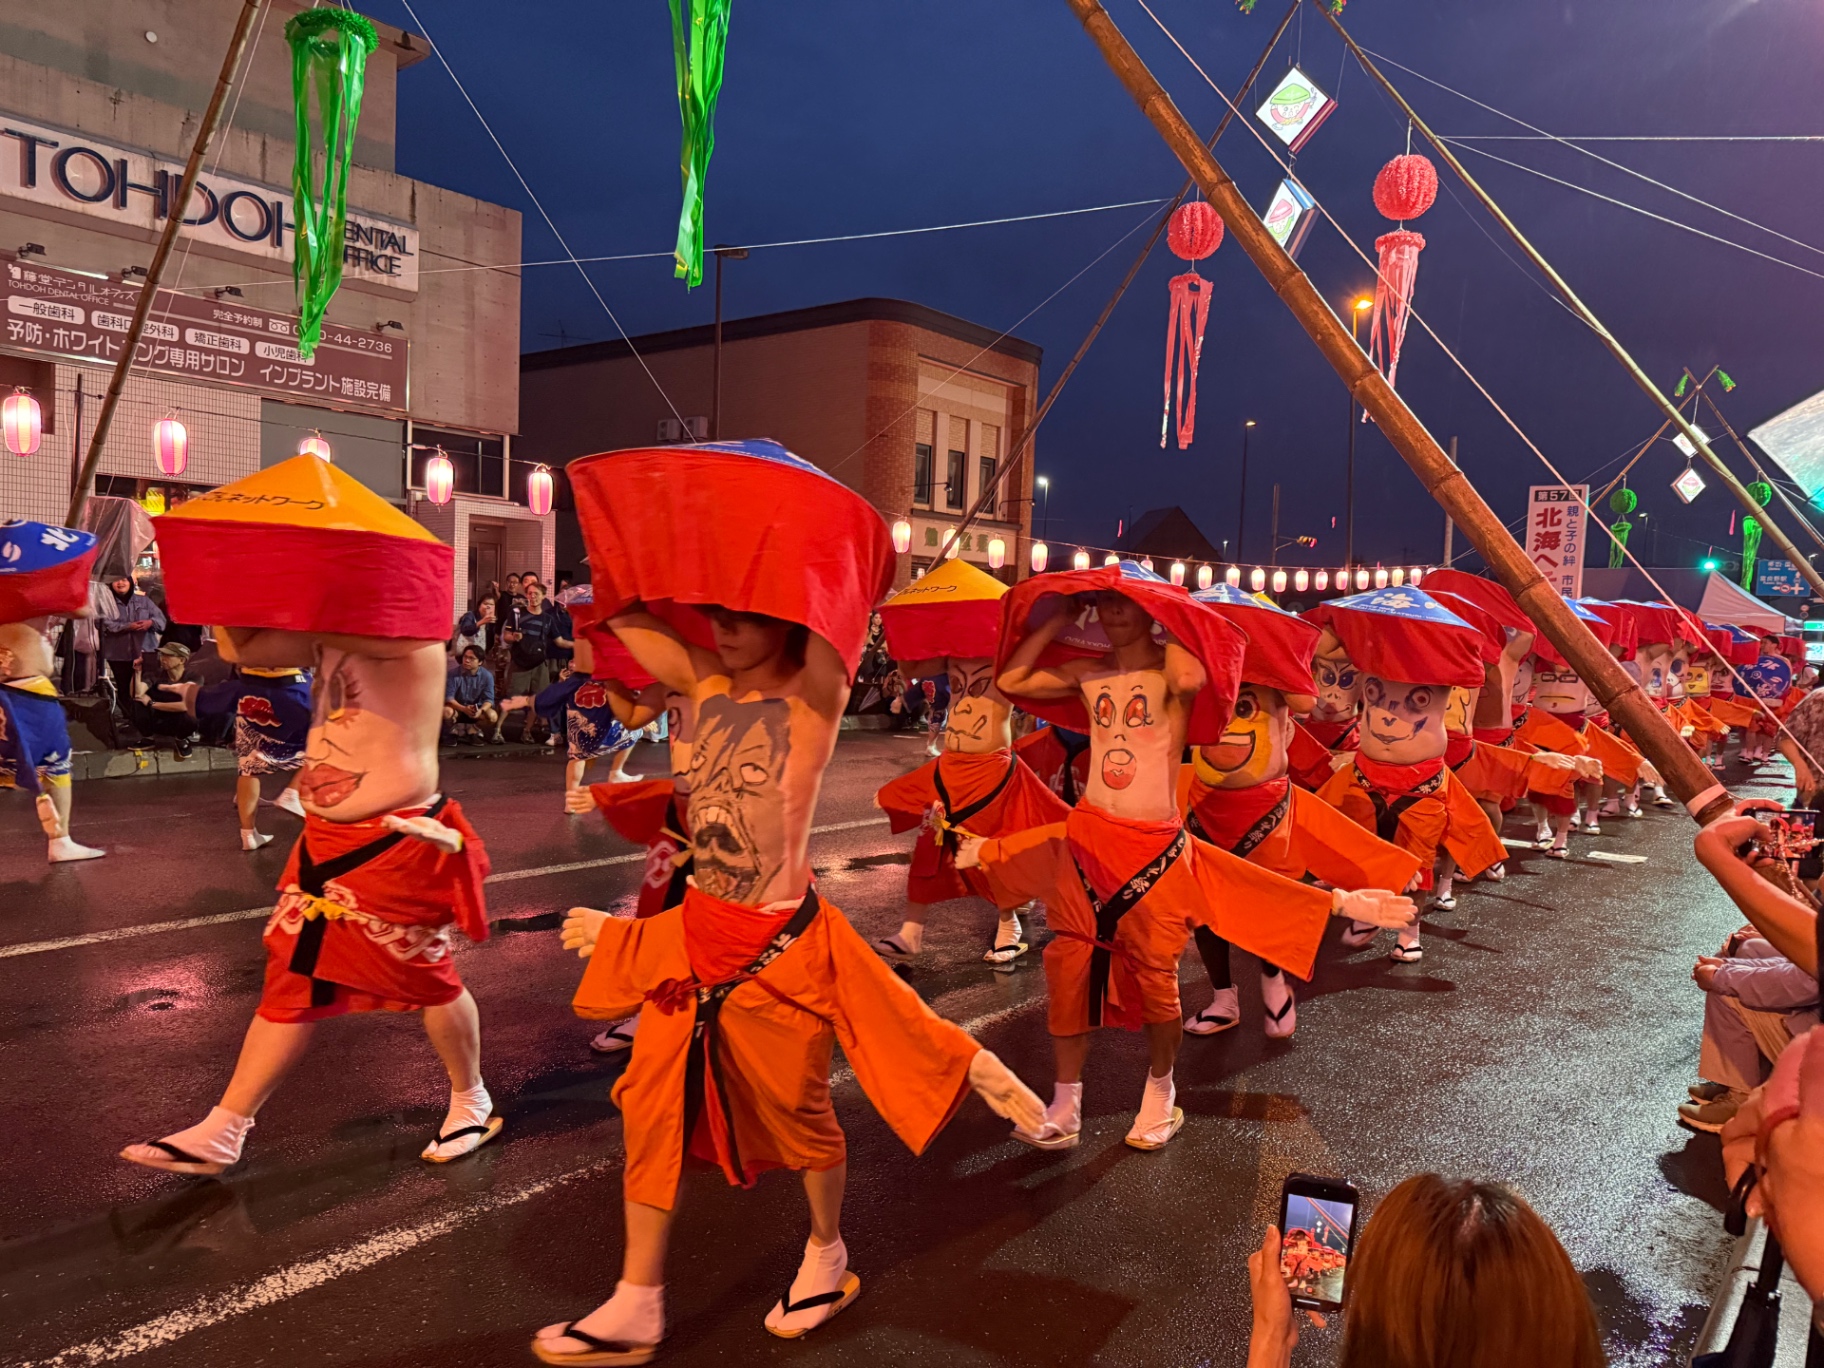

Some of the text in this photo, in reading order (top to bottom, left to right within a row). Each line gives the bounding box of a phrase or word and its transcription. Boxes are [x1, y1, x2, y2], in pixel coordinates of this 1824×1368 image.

[343, 218, 414, 256] ENTAL
[343, 245, 401, 276] FFICE
[8, 279, 110, 306] TOHDOH DENTAL OFFICE
[19, 302, 76, 321] 一般歯科
[213, 309, 262, 328] 完全予約制
[194, 331, 242, 351] 矯正歯科
[292, 324, 392, 354] 00-44-2736
[7, 319, 391, 403] 予防・ホワイトング専用サロン インプラント施設完備
[1537, 490, 1582, 501] 第57回
[1563, 505, 1579, 567] 親と子の絆
